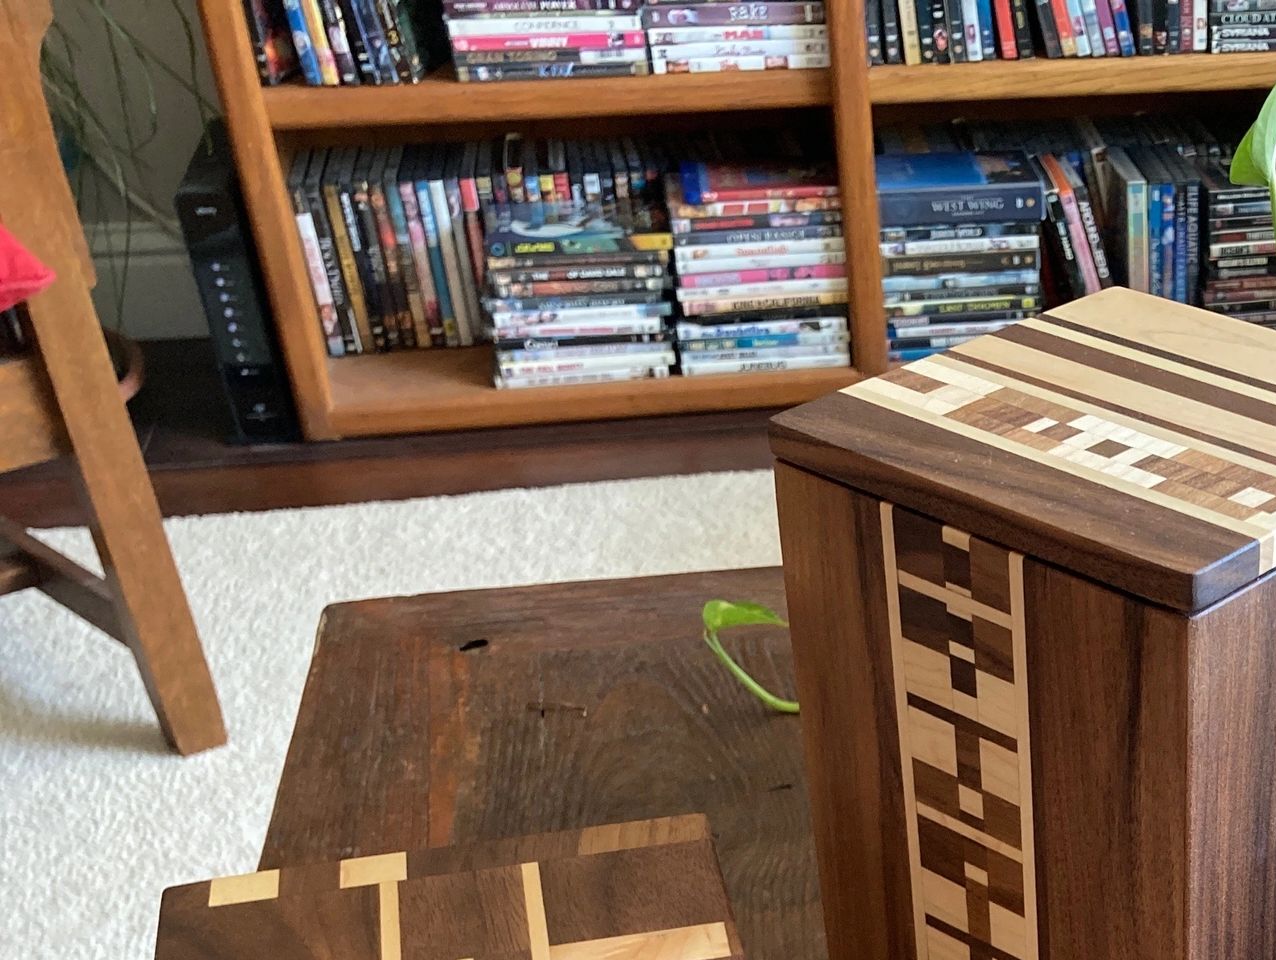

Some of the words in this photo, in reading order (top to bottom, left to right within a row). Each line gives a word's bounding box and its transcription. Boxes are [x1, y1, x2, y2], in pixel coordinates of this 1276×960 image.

[1220, 13, 1262, 25] CLOUD
[1220, 28, 1270, 38] SYRIANA
[1219, 42, 1270, 52] SYRIANA
[930, 199, 964, 213] WEST
[967, 197, 1005, 211] WING
[1188, 193, 1200, 215] LIFE
[1078, 200, 1100, 246] AROUND
[1187, 215, 1199, 265] AQUATIC
